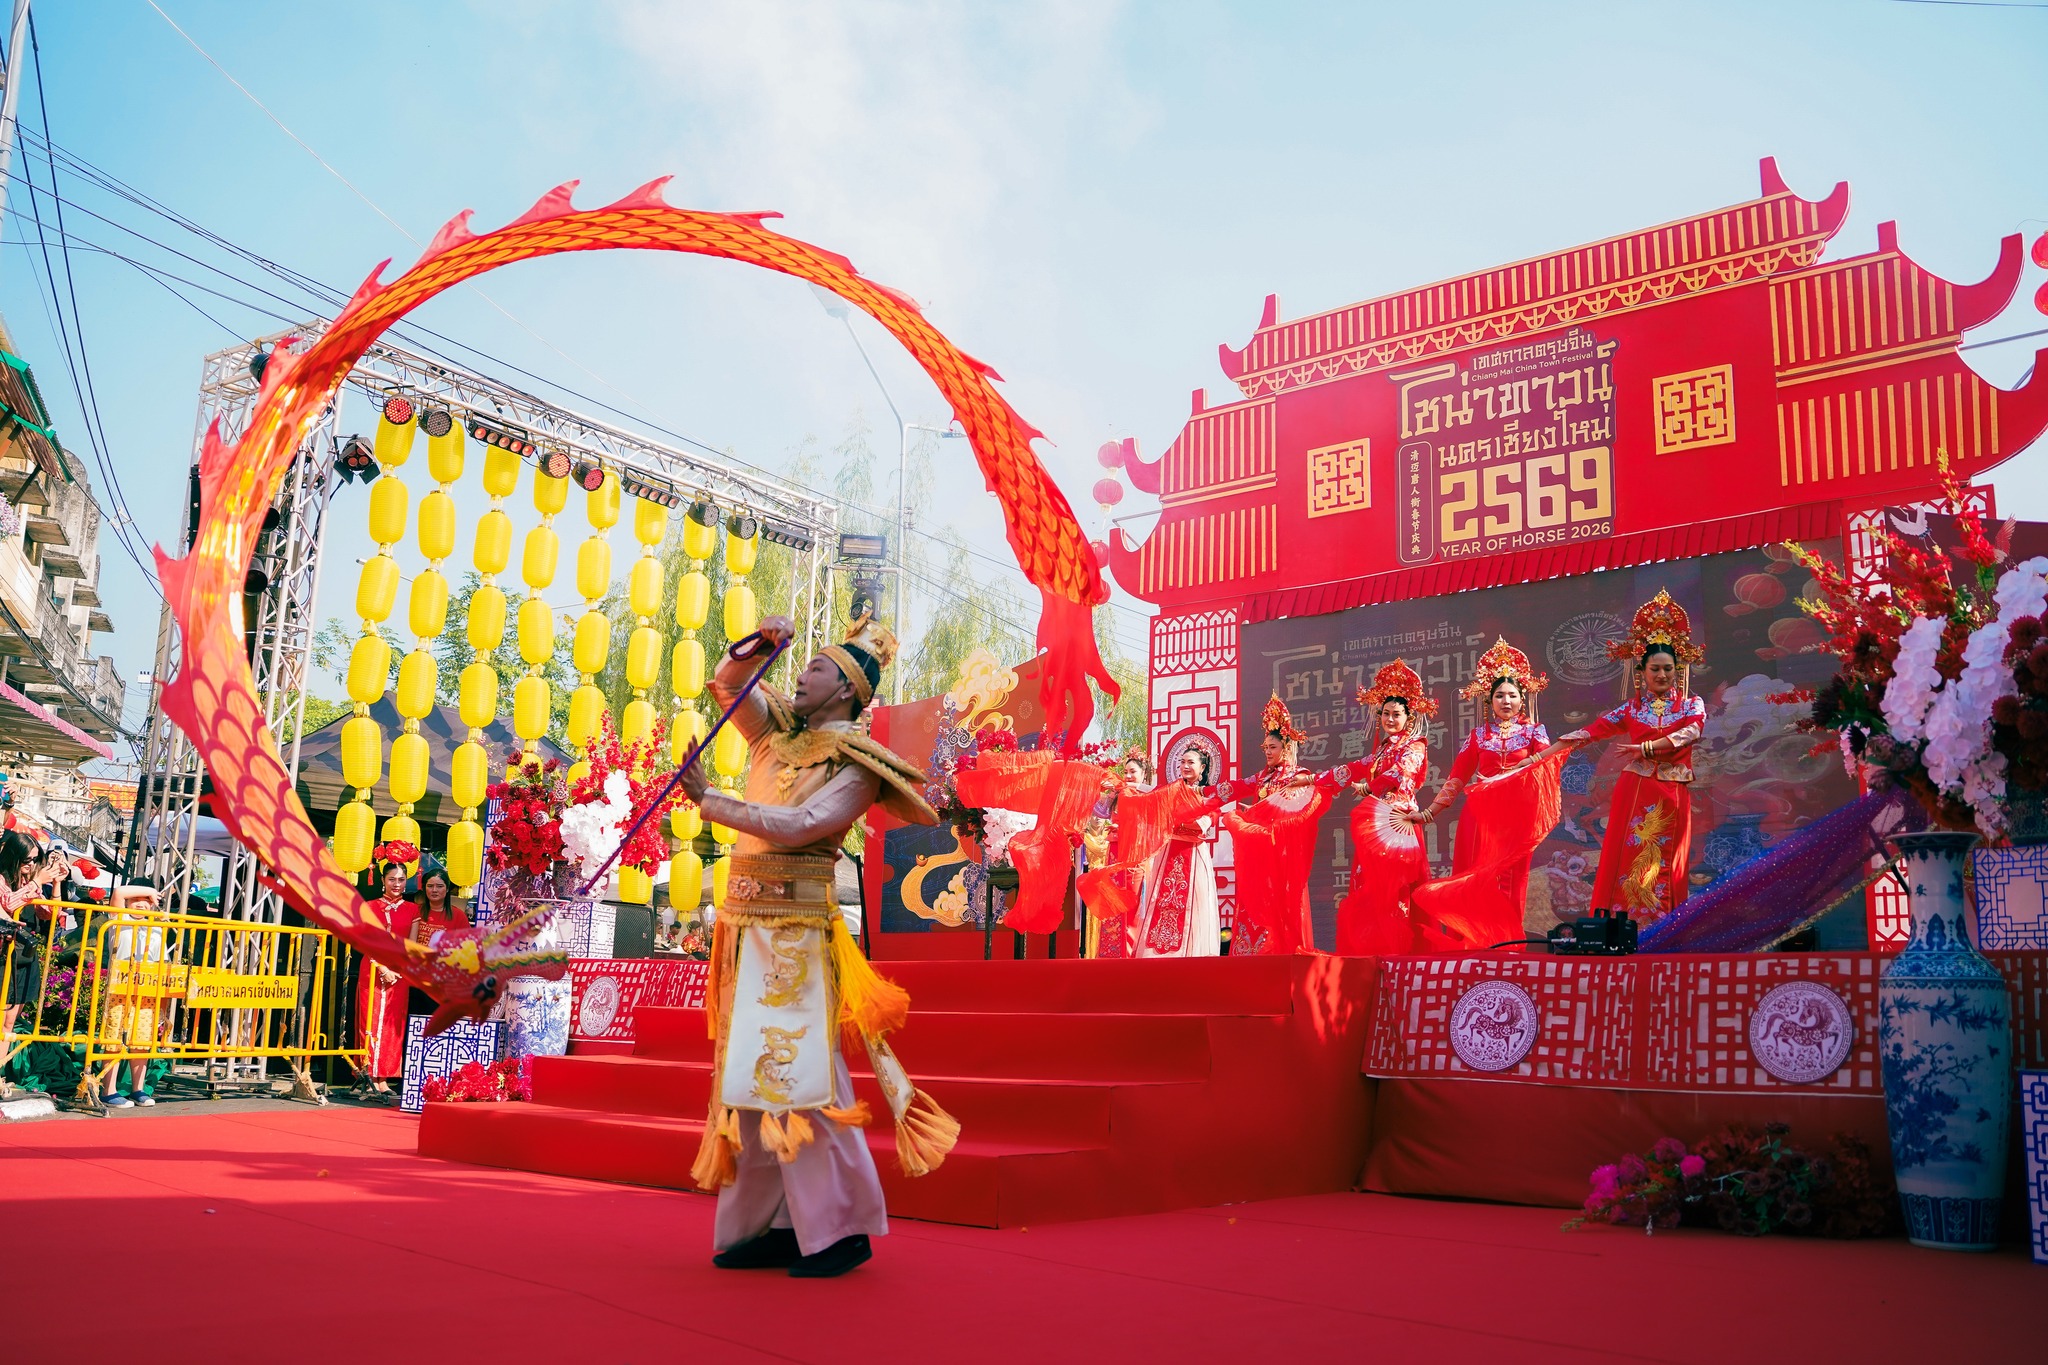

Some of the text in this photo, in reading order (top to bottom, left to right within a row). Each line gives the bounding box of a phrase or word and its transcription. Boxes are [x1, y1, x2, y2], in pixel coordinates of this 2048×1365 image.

[1473, 328, 1593, 370] เทศกาลตรุษจีน
[1471, 351, 1594, 382] Chiang Mai China Town Festival
[1438, 403, 1612, 468] นครเชียงใหม่
[1440, 446, 1612, 543] 2569
[1441, 521, 1611, 558] YEAR OF HORSE 2026
[1342, 652, 1368, 660] Chiang
[1385, 647, 1407, 655] China
[1431, 640, 1463, 650] Festival
[1343, 621, 1462, 652] เทศกาลตรุษจีน
[196, 980, 293, 999] ทศบาลนครเชียงใหม่
